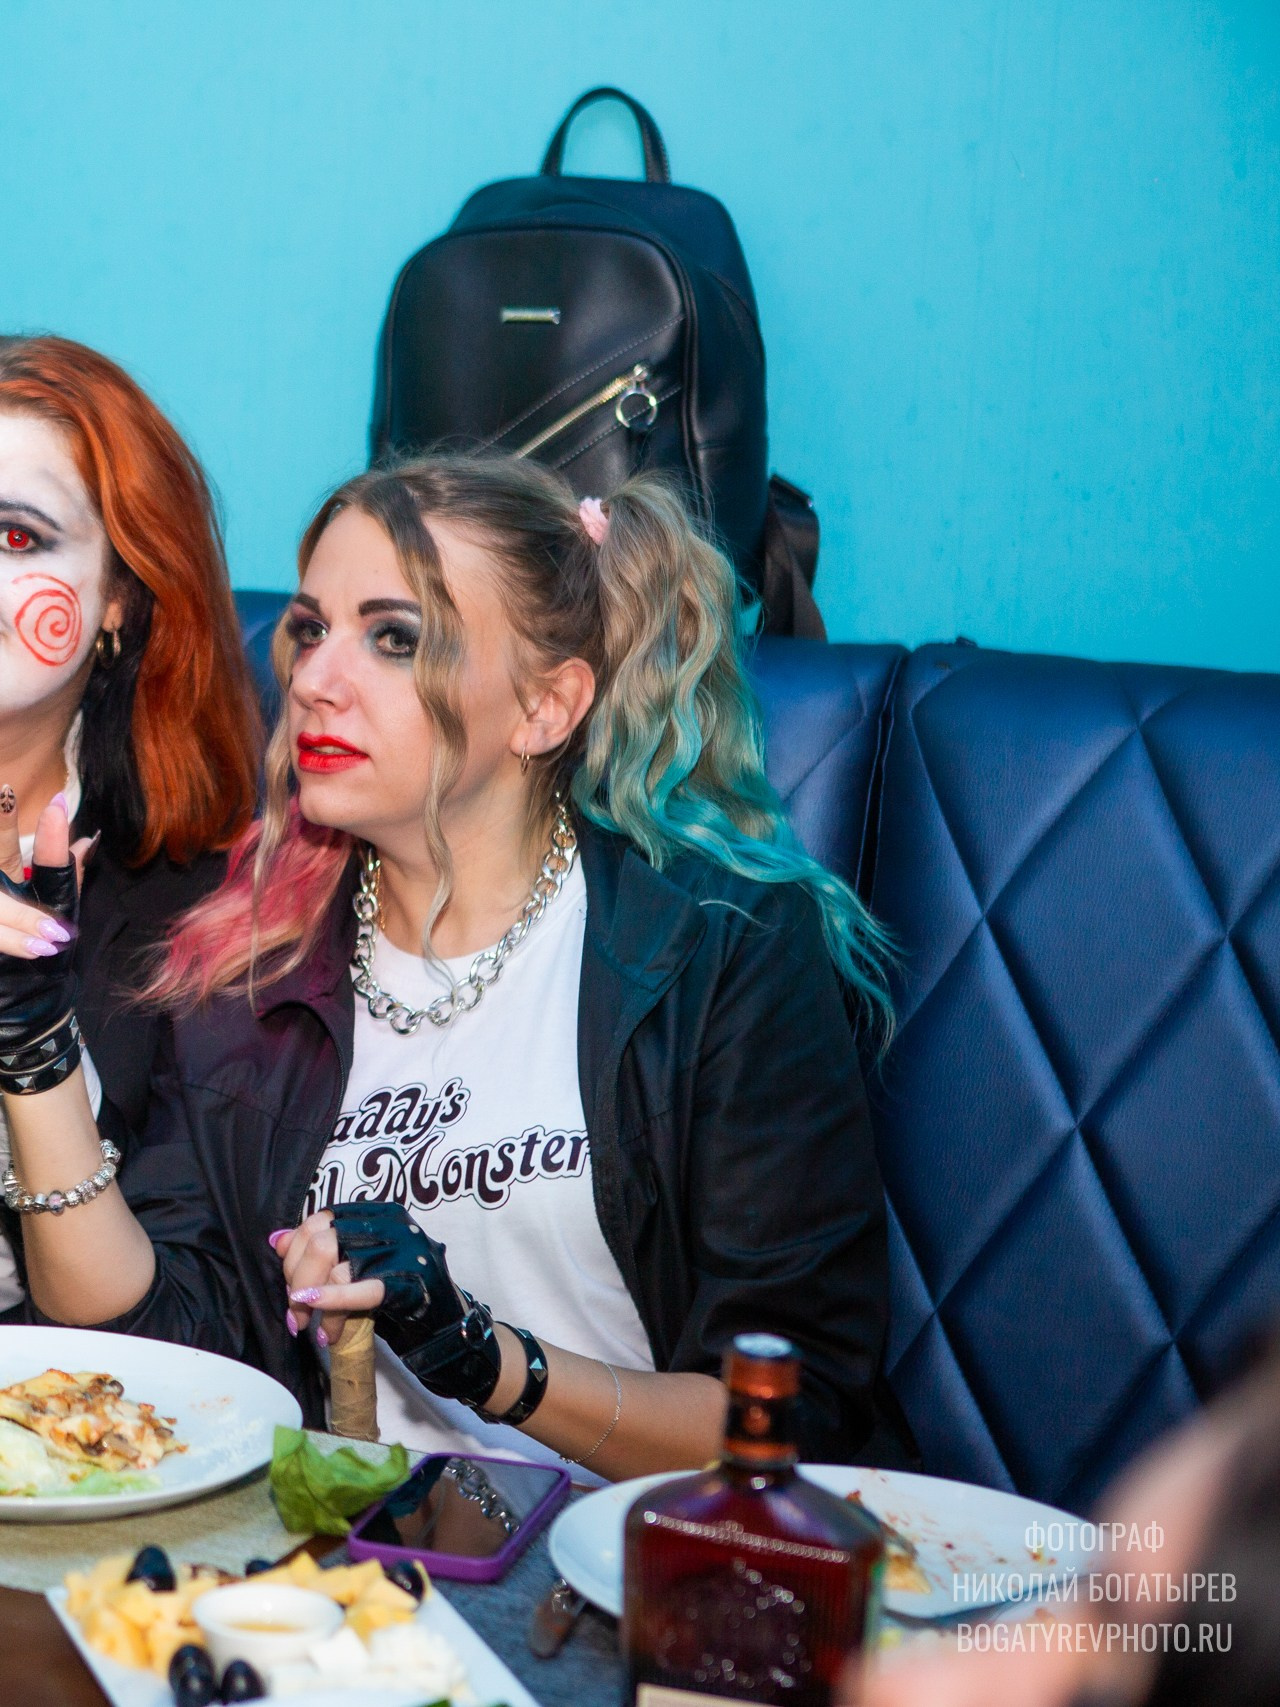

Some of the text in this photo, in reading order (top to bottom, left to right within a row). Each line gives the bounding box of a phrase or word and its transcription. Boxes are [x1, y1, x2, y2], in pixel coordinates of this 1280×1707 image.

[327, 1080, 468, 1146] addy's
[304, 1130, 590, 1218] il Monster
